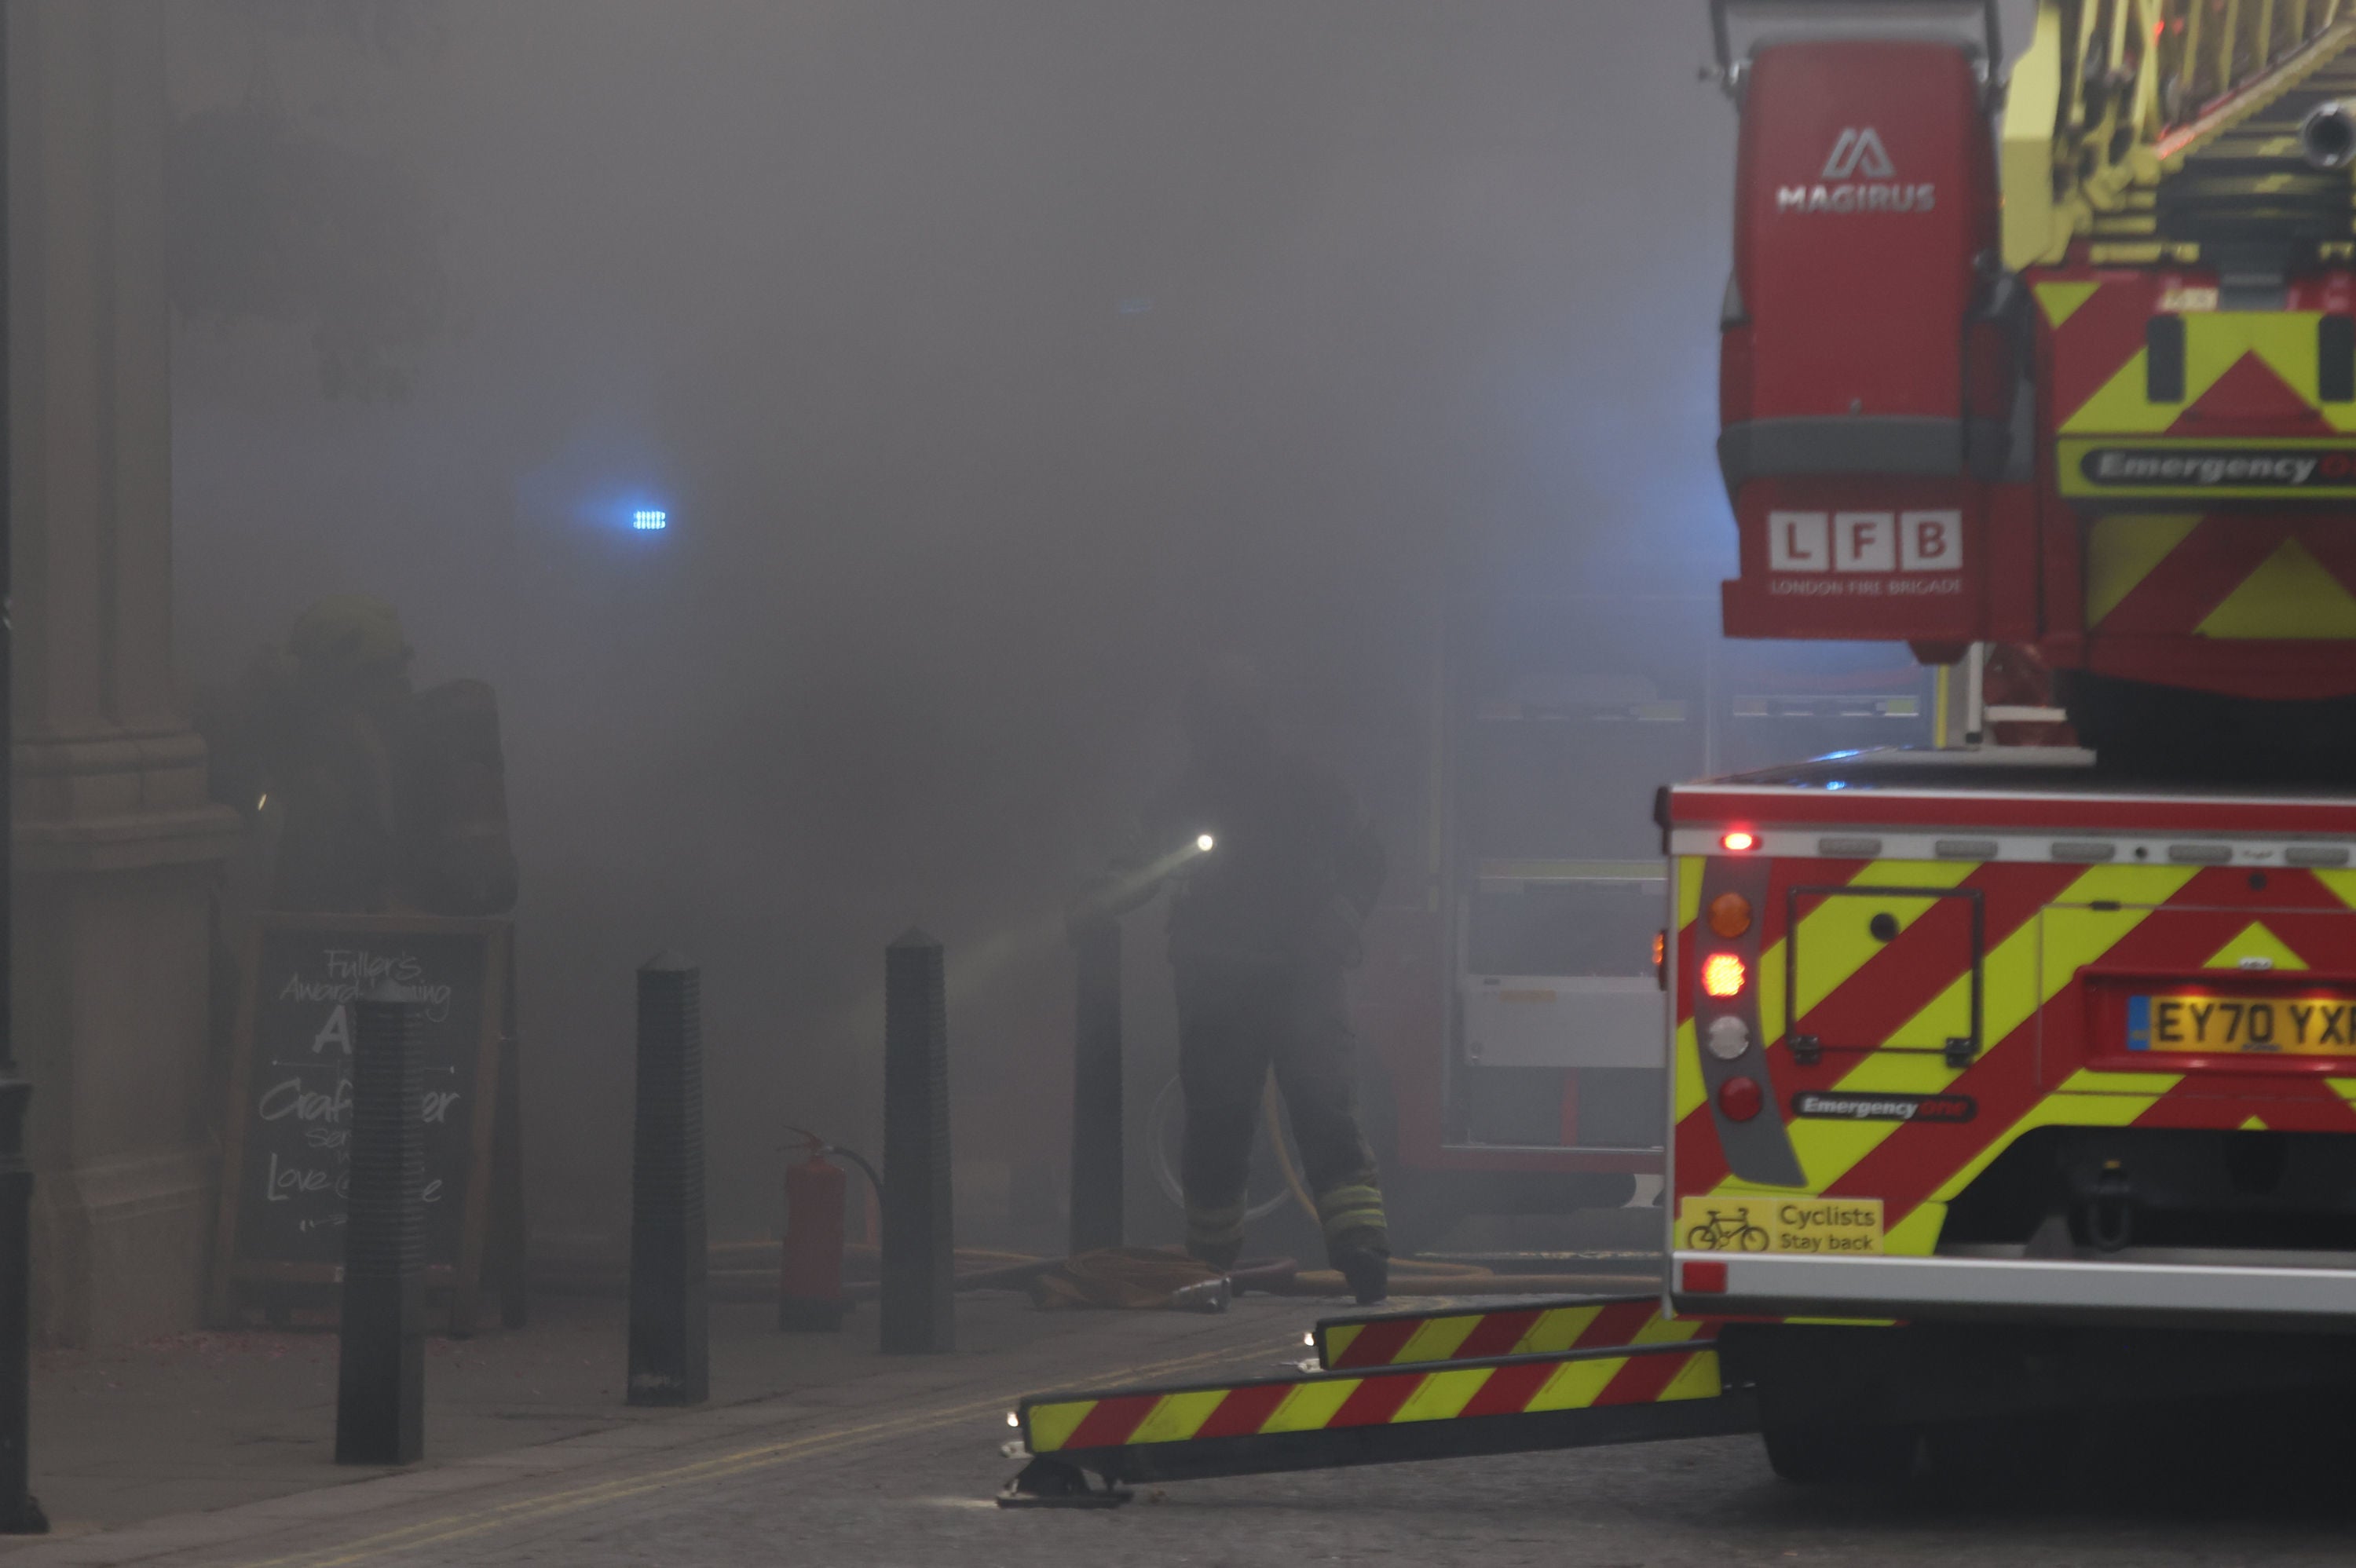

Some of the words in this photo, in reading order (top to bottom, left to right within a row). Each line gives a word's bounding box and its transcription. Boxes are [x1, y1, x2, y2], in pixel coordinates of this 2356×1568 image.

[1776, 183, 1937, 214] MAGIRUS
[1772, 580, 1844, 596] LONDON
[1847, 580, 1882, 595] FIRE
[1888, 579, 1961, 595] BRIGADE
[323, 948, 423, 981] Fuller's
[2159, 1002, 2275, 1044] EY70
[258, 1076, 353, 1124] Craf
[267, 1151, 332, 1202] Love
[1780, 1204, 1876, 1230] Cyclists
[1780, 1233, 1822, 1253] Stay
[1828, 1234, 1874, 1251] back
